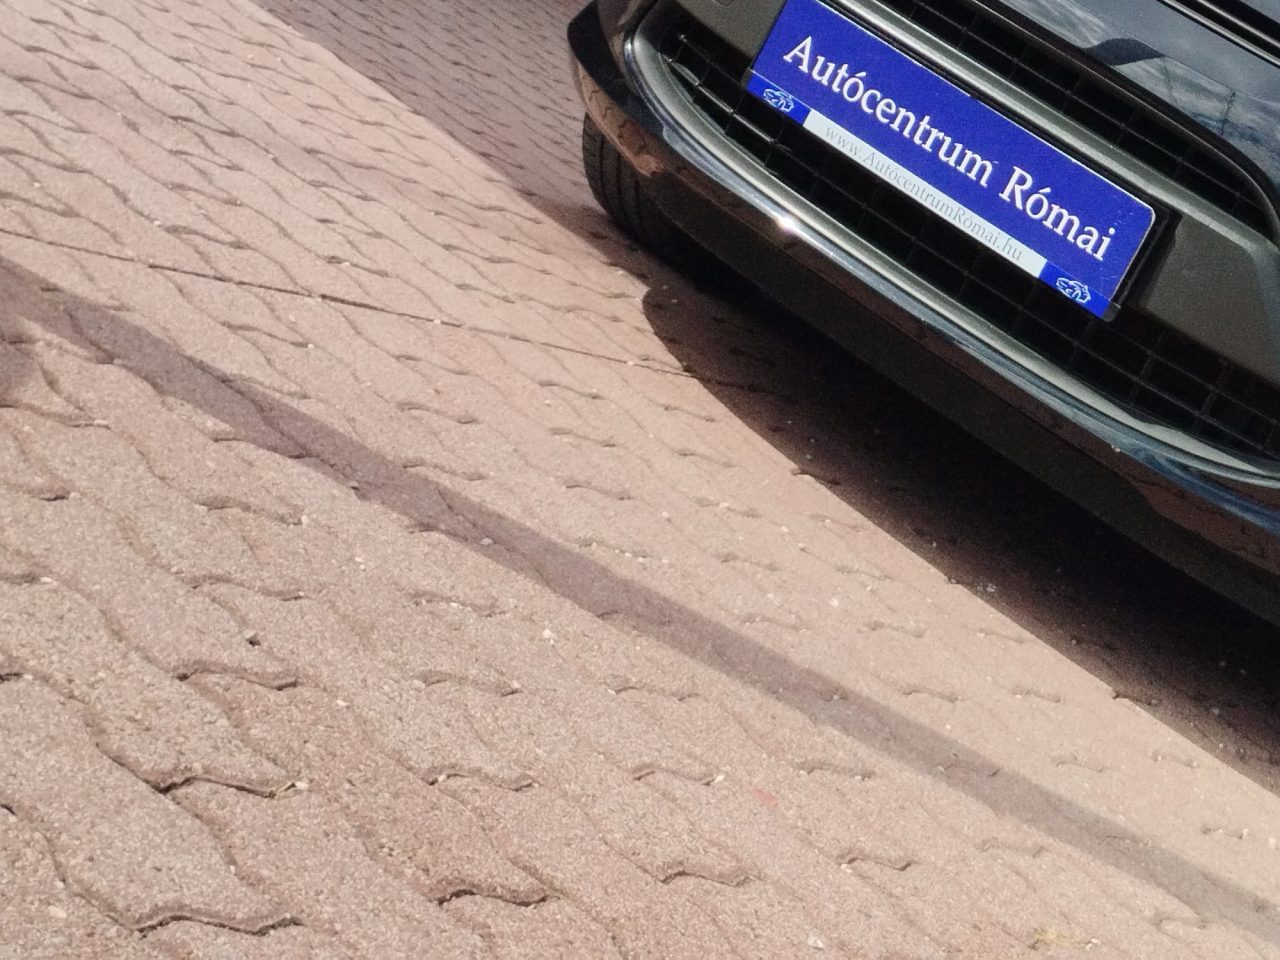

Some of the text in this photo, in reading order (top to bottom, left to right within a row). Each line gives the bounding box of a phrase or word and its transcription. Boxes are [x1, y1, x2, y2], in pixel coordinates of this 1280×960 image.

[783, 35, 1115, 262] Autócentrum Római
[825, 124, 1023, 262] www.AutócentrumRómai.hu
